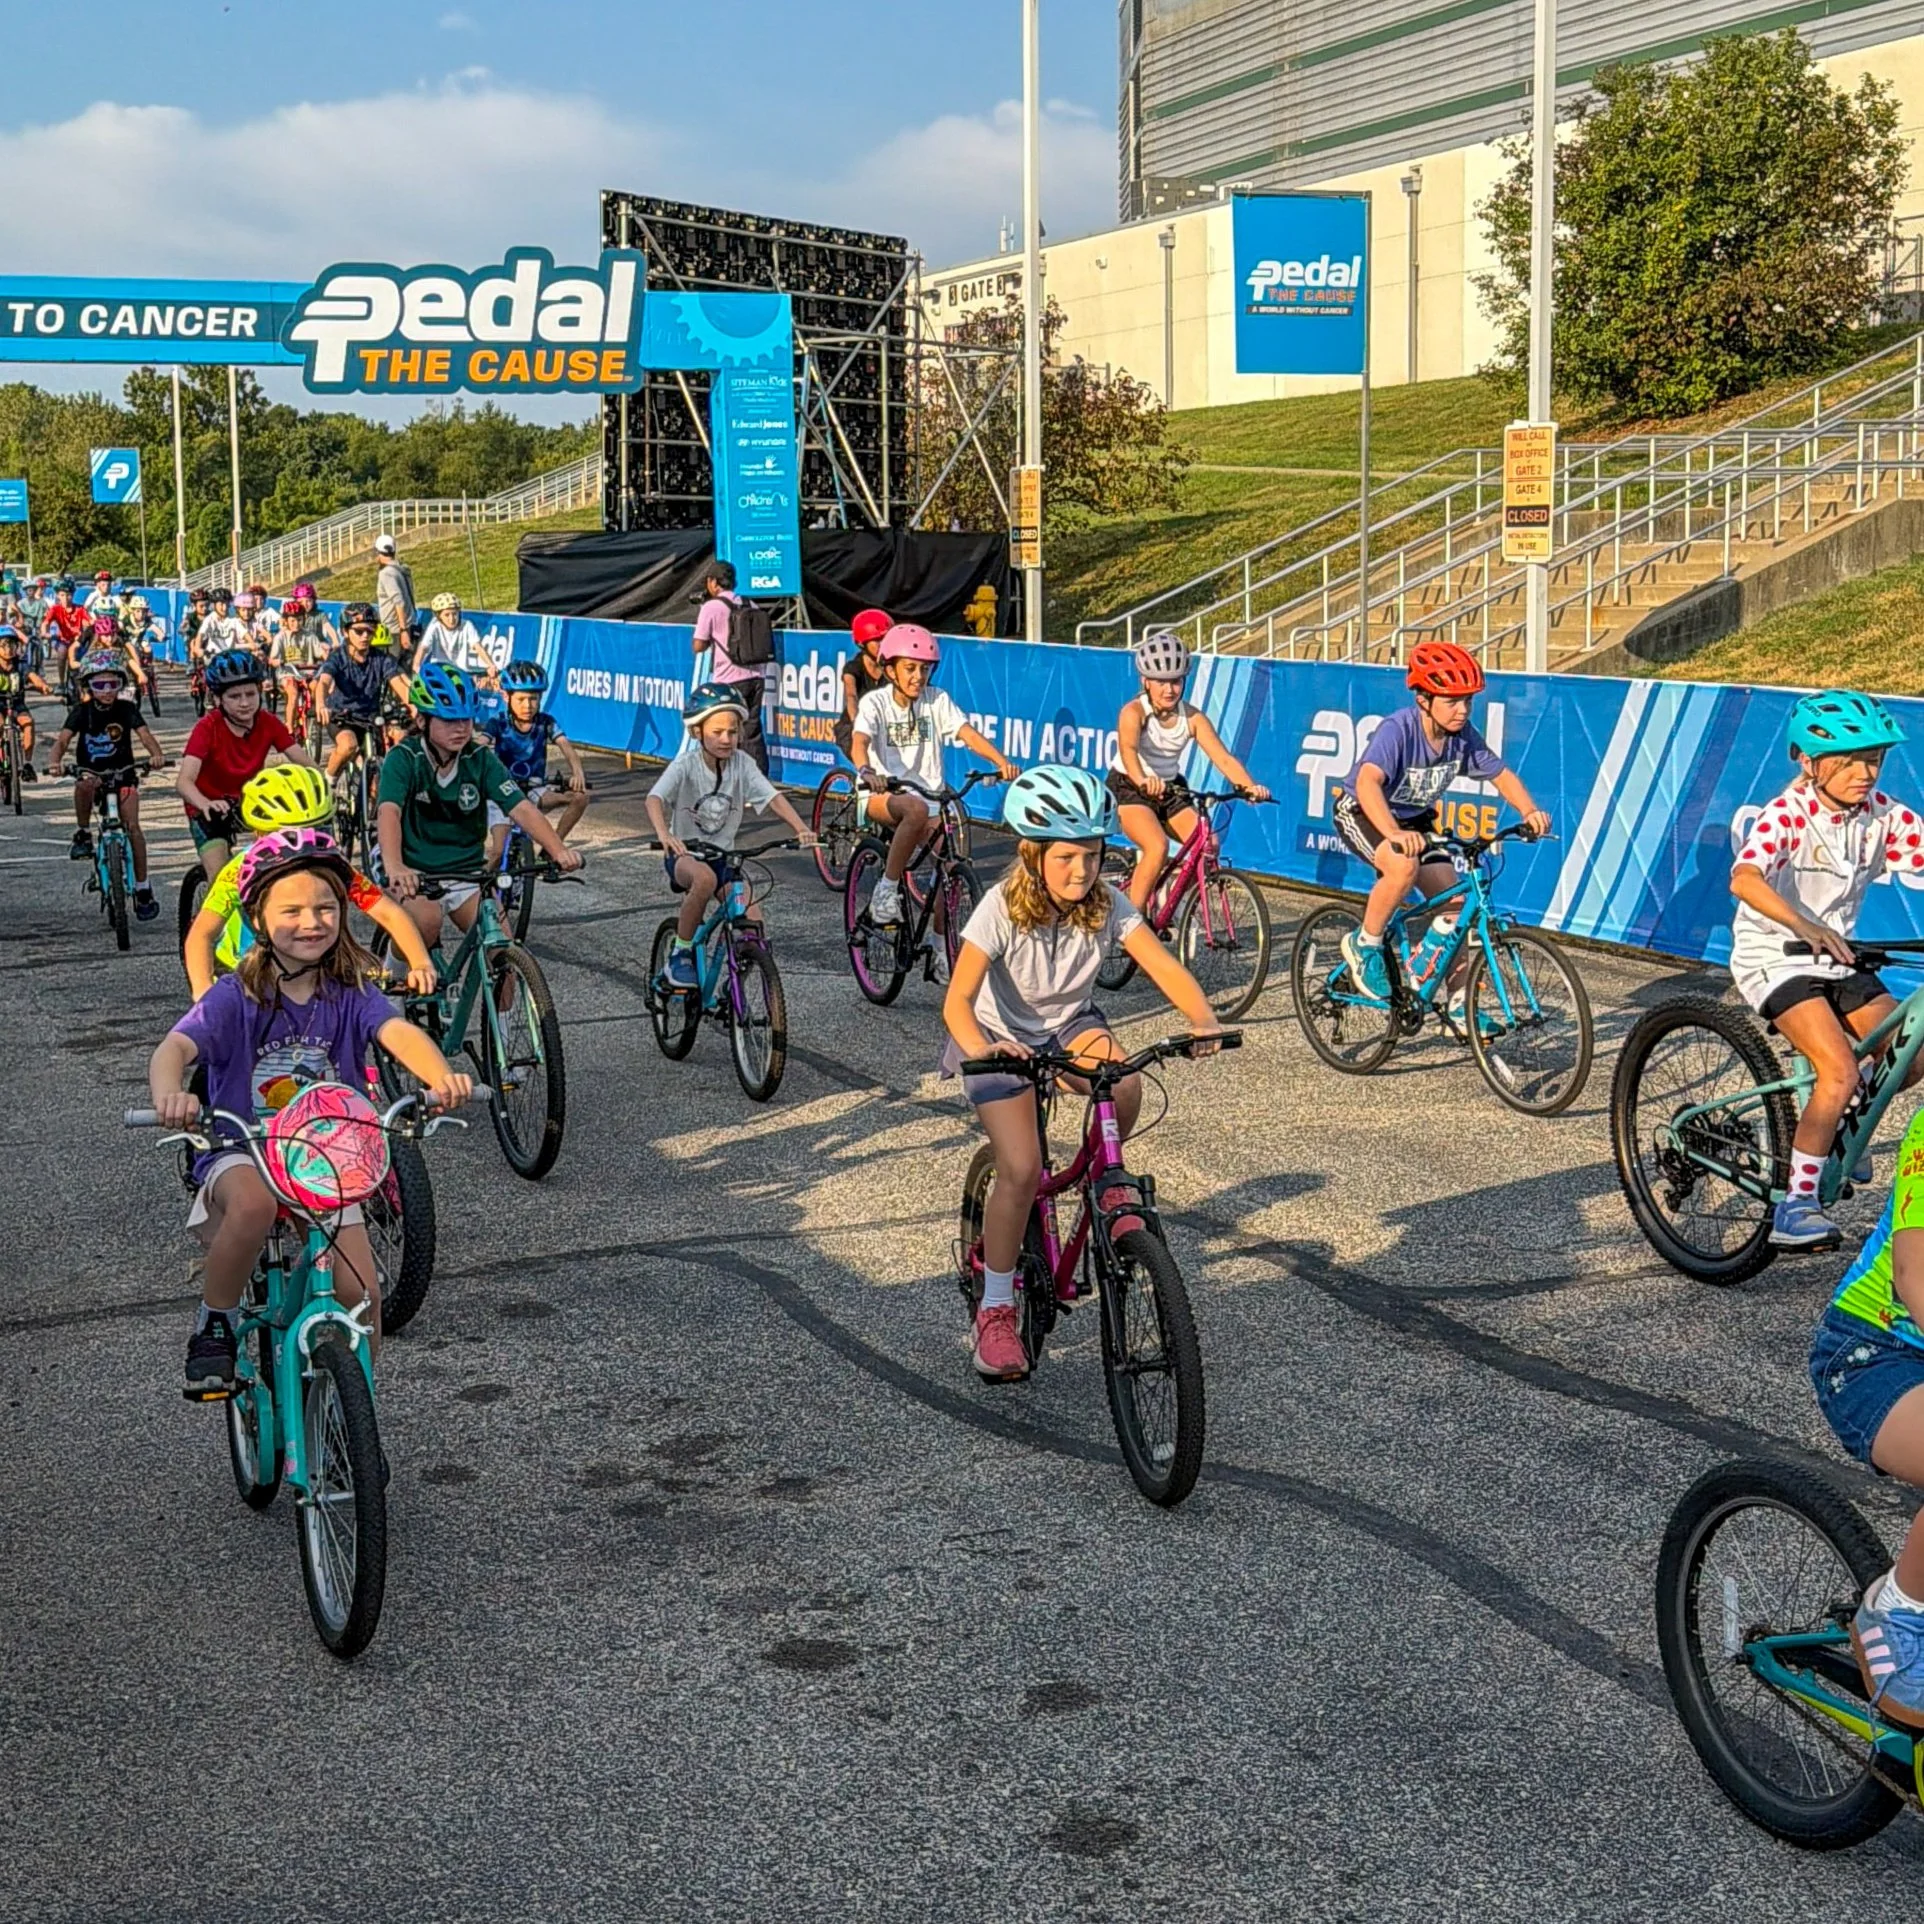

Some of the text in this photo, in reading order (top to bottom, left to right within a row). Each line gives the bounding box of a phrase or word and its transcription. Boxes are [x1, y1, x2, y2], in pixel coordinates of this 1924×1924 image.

[961, 278, 994, 302] GATE
[1268, 288, 1356, 303] THE CAUSE
[8, 303, 258, 337] TO CANCER
[359, 350, 627, 382] THE CAUSE
[1511, 431, 1547, 441] WILL CALL
[1510, 448, 1549, 459] BOX OFFICE
[1516, 465, 1542, 476] GATE 2
[1516, 484, 1542, 494] GATE 4
[1507, 509, 1548, 523] CLOSED
[1013, 529, 1038, 540] CLOSED
[751, 576, 782, 589] RGA
[482, 624, 514, 671] dal
[567, 667, 685, 711] CURES IN MOTION
[777, 713, 837, 743] THE CAUS
[1003, 717, 1033, 759] IN
[1039, 722, 1120, 771] ACTIO
[1434, 799, 1498, 841] USE
[1305, 832, 1352, 855] A WOR
